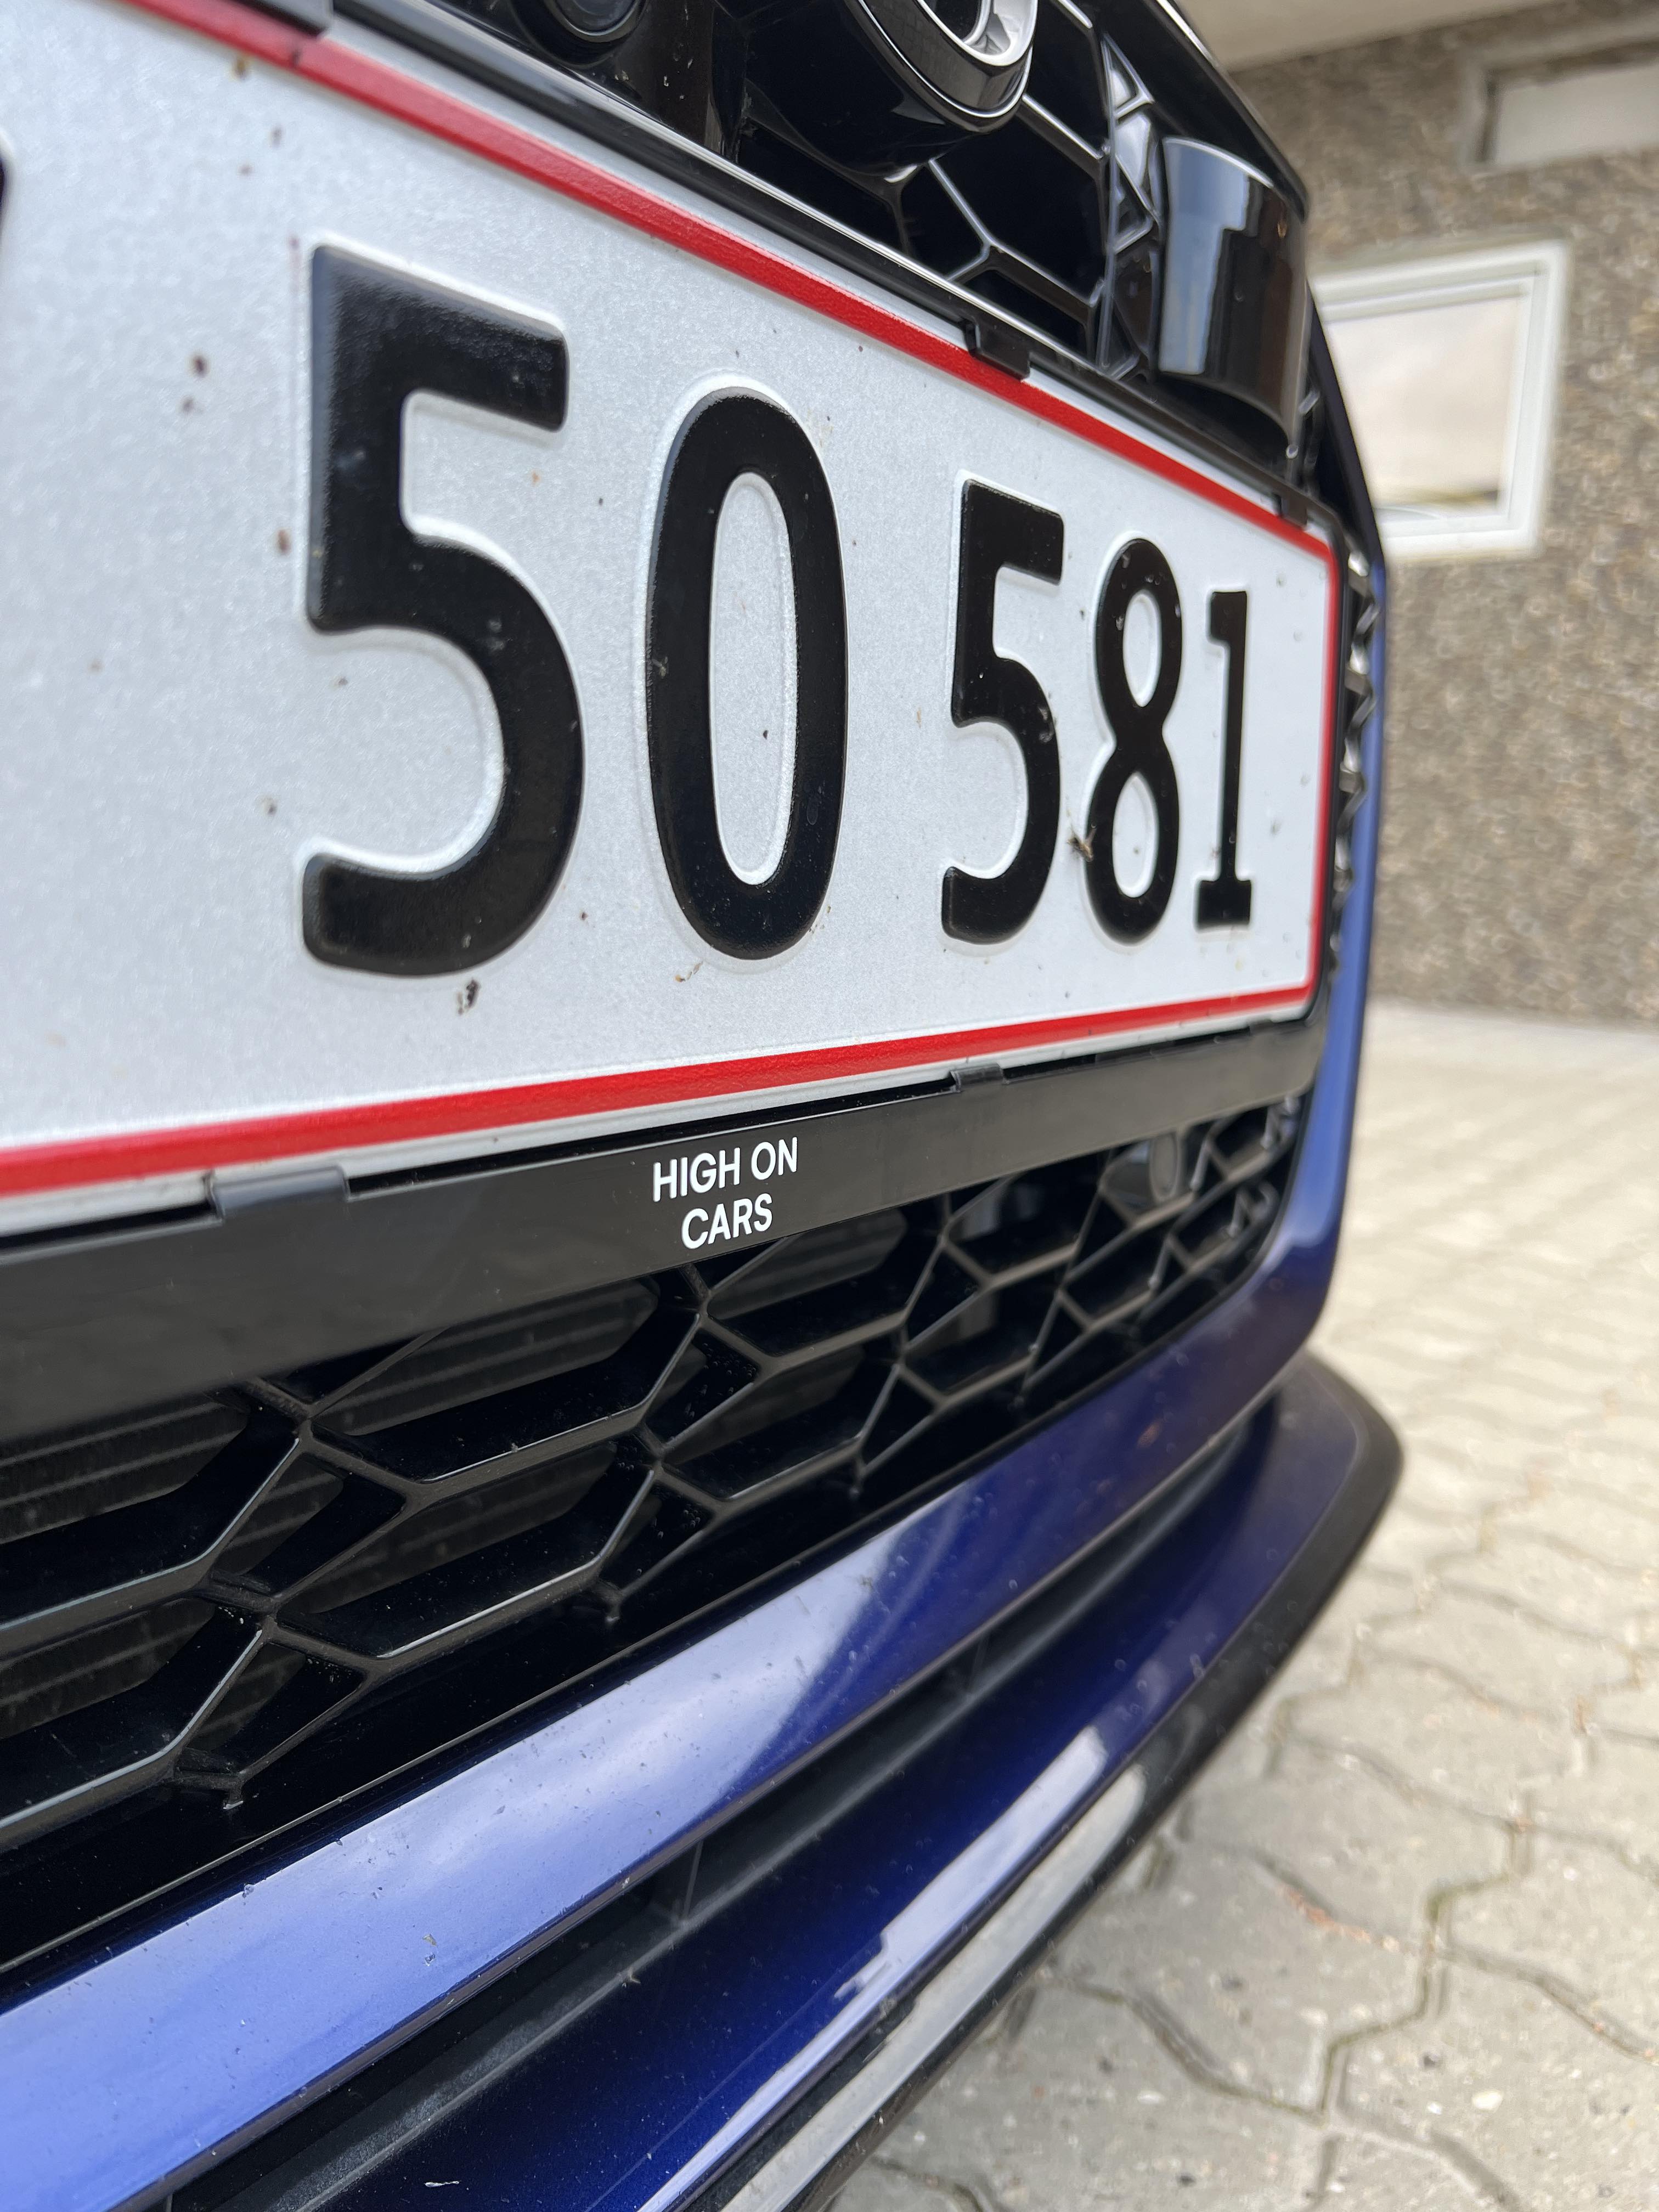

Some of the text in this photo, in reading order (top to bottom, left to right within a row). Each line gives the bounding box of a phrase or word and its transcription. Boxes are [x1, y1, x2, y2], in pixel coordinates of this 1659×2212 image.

[303, 247, 1252, 978] 50 581
[653, 1137, 798, 1202] HIGH ON
[681, 1193, 773, 1249] CARS
